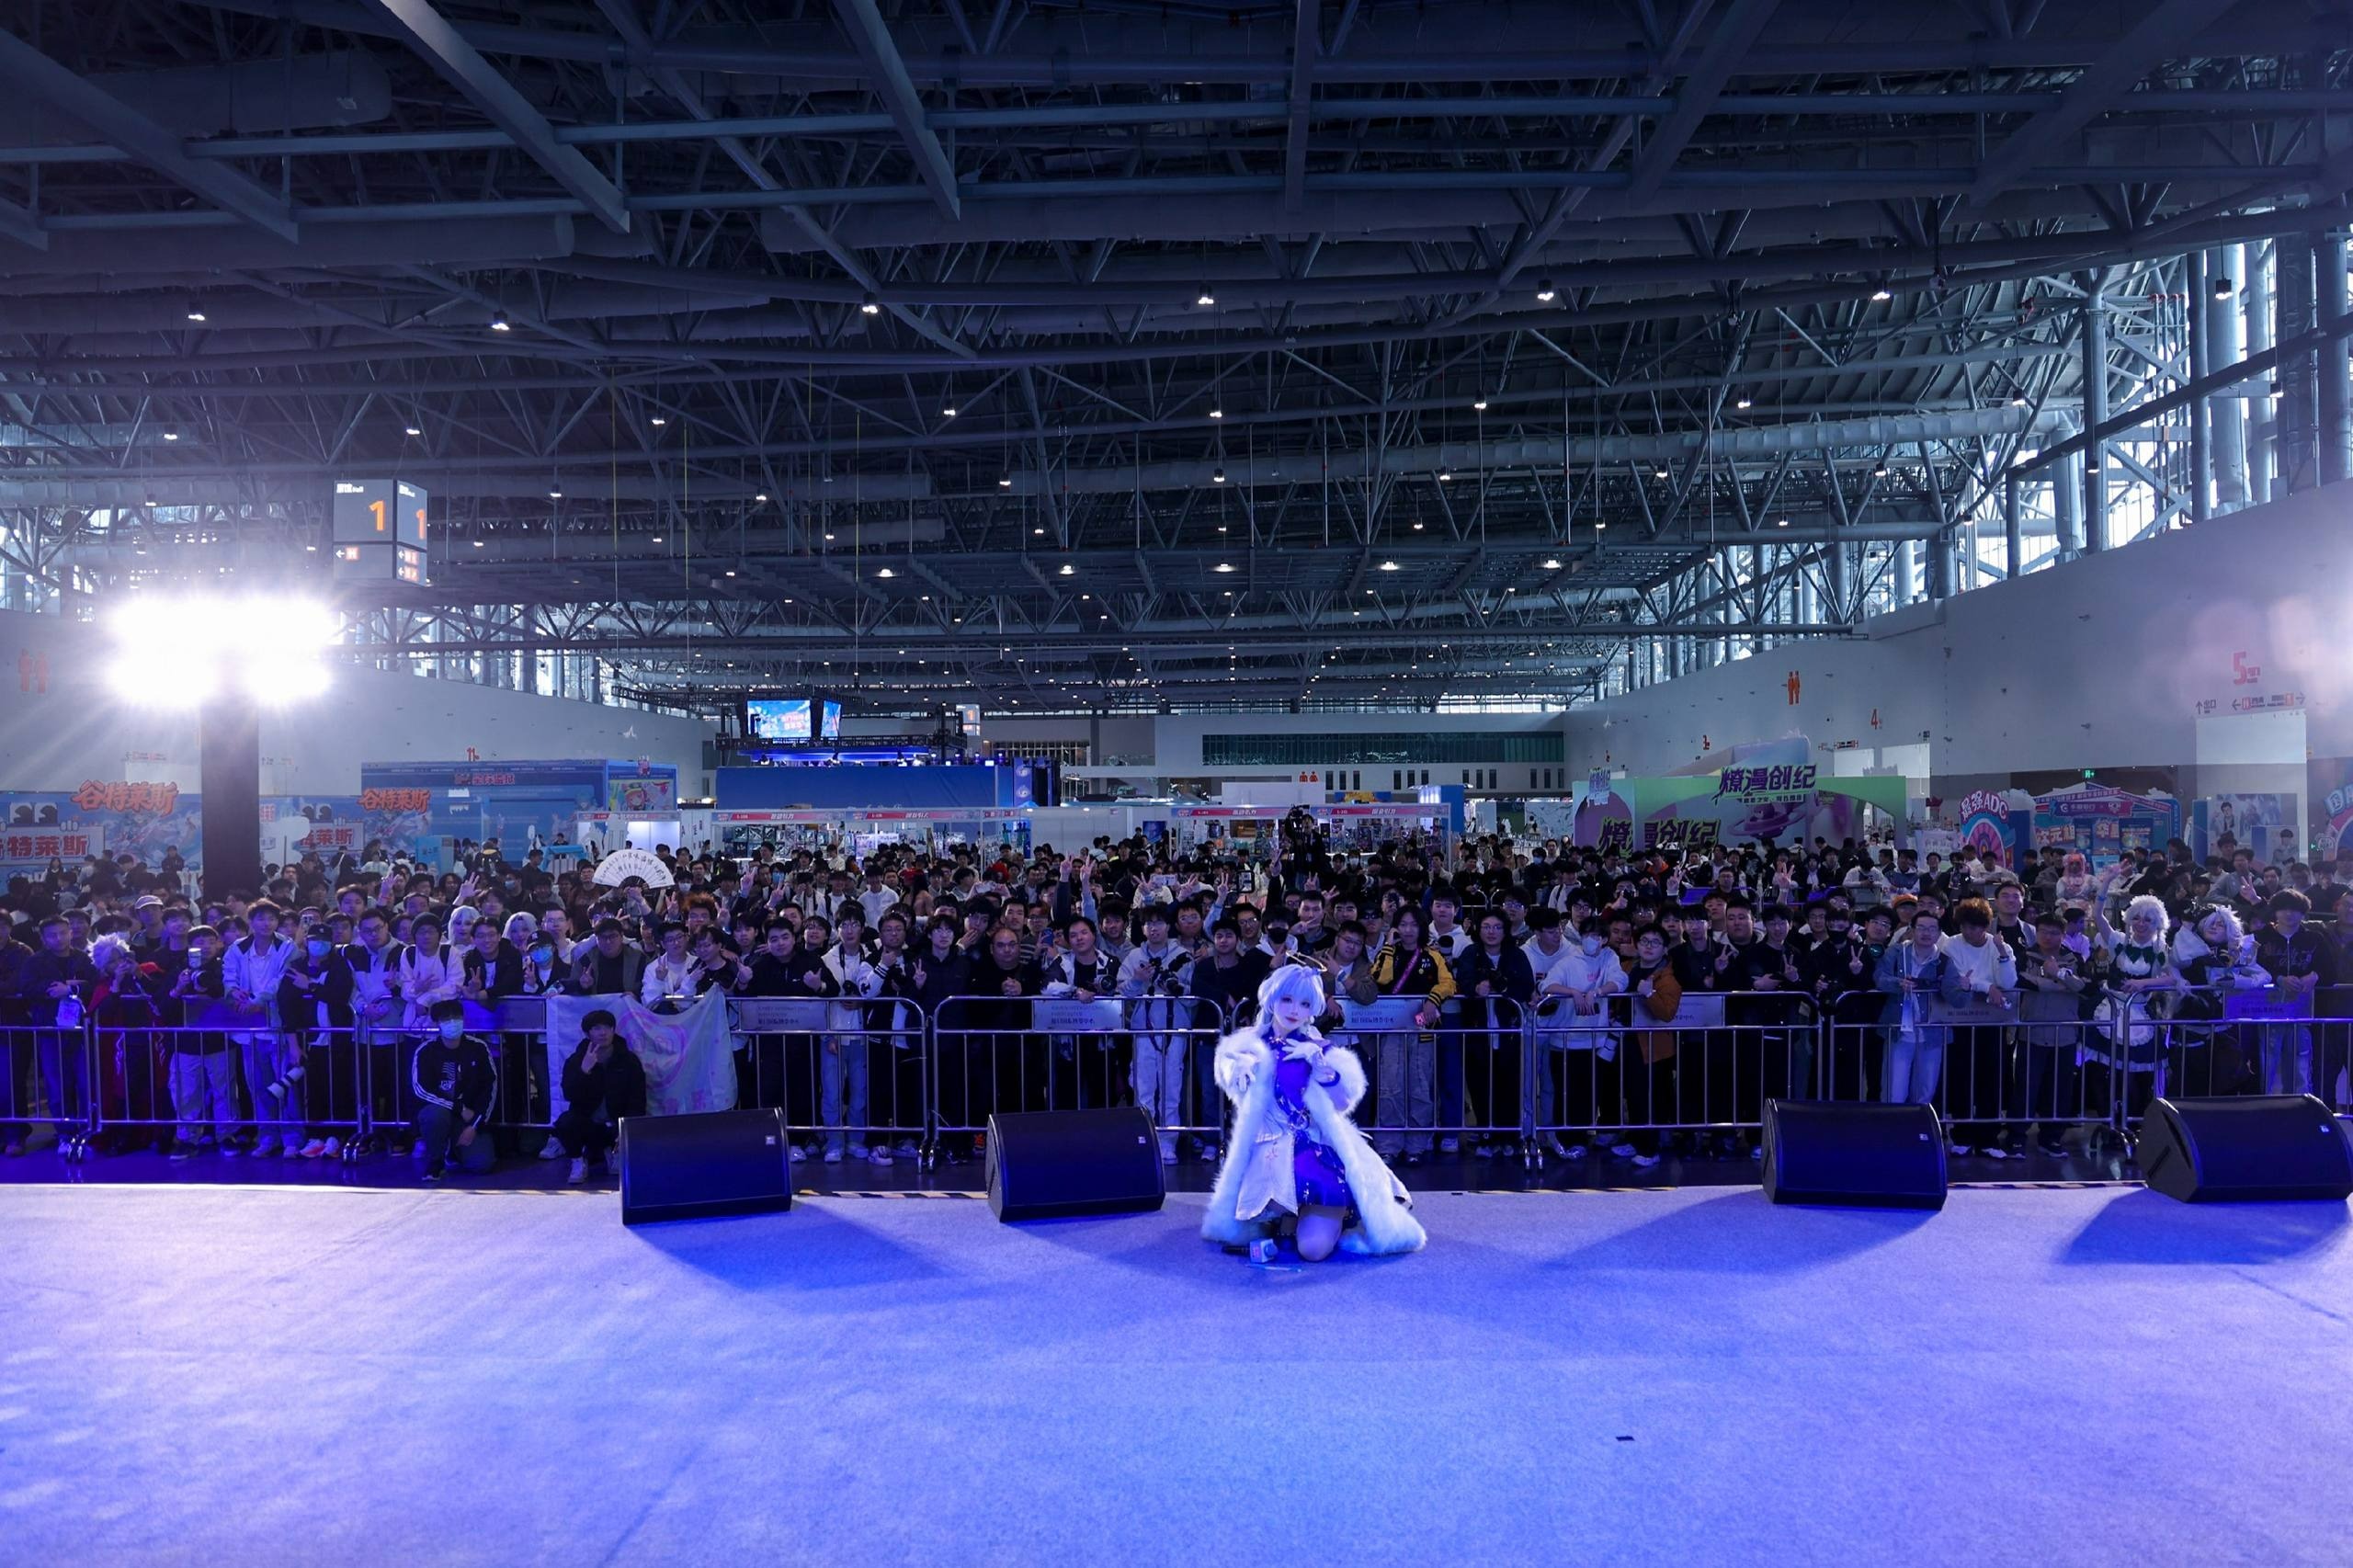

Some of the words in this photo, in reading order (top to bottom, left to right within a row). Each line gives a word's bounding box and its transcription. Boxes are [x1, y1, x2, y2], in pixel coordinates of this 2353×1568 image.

[369, 499, 385, 531] 1
[415, 508, 426, 540] 1
[2234, 651, 2247, 686] 5
[73, 781, 178, 817] 谷特莱斯
[357, 788, 430, 813] 谷特莱斯
[1961, 790, 2008, 822] 最强ADC
[0, 834, 89, 859] 特莱斯
